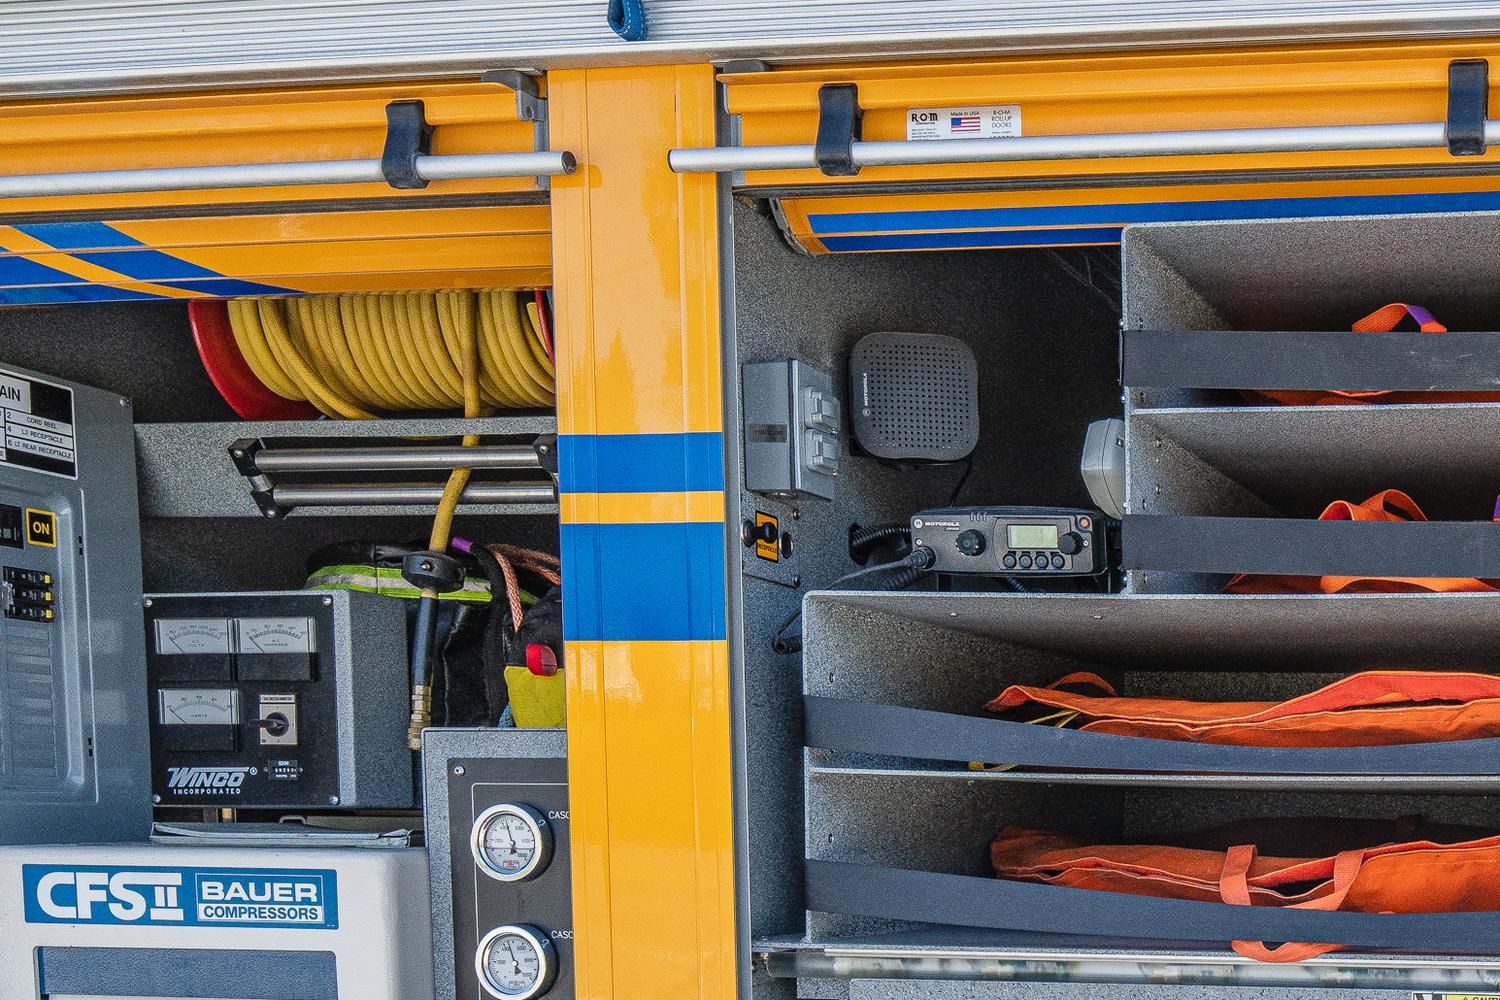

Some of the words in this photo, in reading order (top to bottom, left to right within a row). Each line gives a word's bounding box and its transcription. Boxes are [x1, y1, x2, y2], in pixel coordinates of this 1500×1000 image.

[6, 411, 12, 419] 2
[26, 416, 42, 426] CORD
[43, 421, 58, 429] REEL
[7, 425, 12, 433] 4
[30, 430, 63, 444] RECEPTACLE
[22, 442, 37, 452] REAR
[38, 446, 72, 459] RECEPTACLE
[33, 521, 50, 535] ON
[167, 766, 250, 788] WINCO
[201, 880, 318, 903] BAUER
[203, 906, 319, 921] COMPRESSORS
